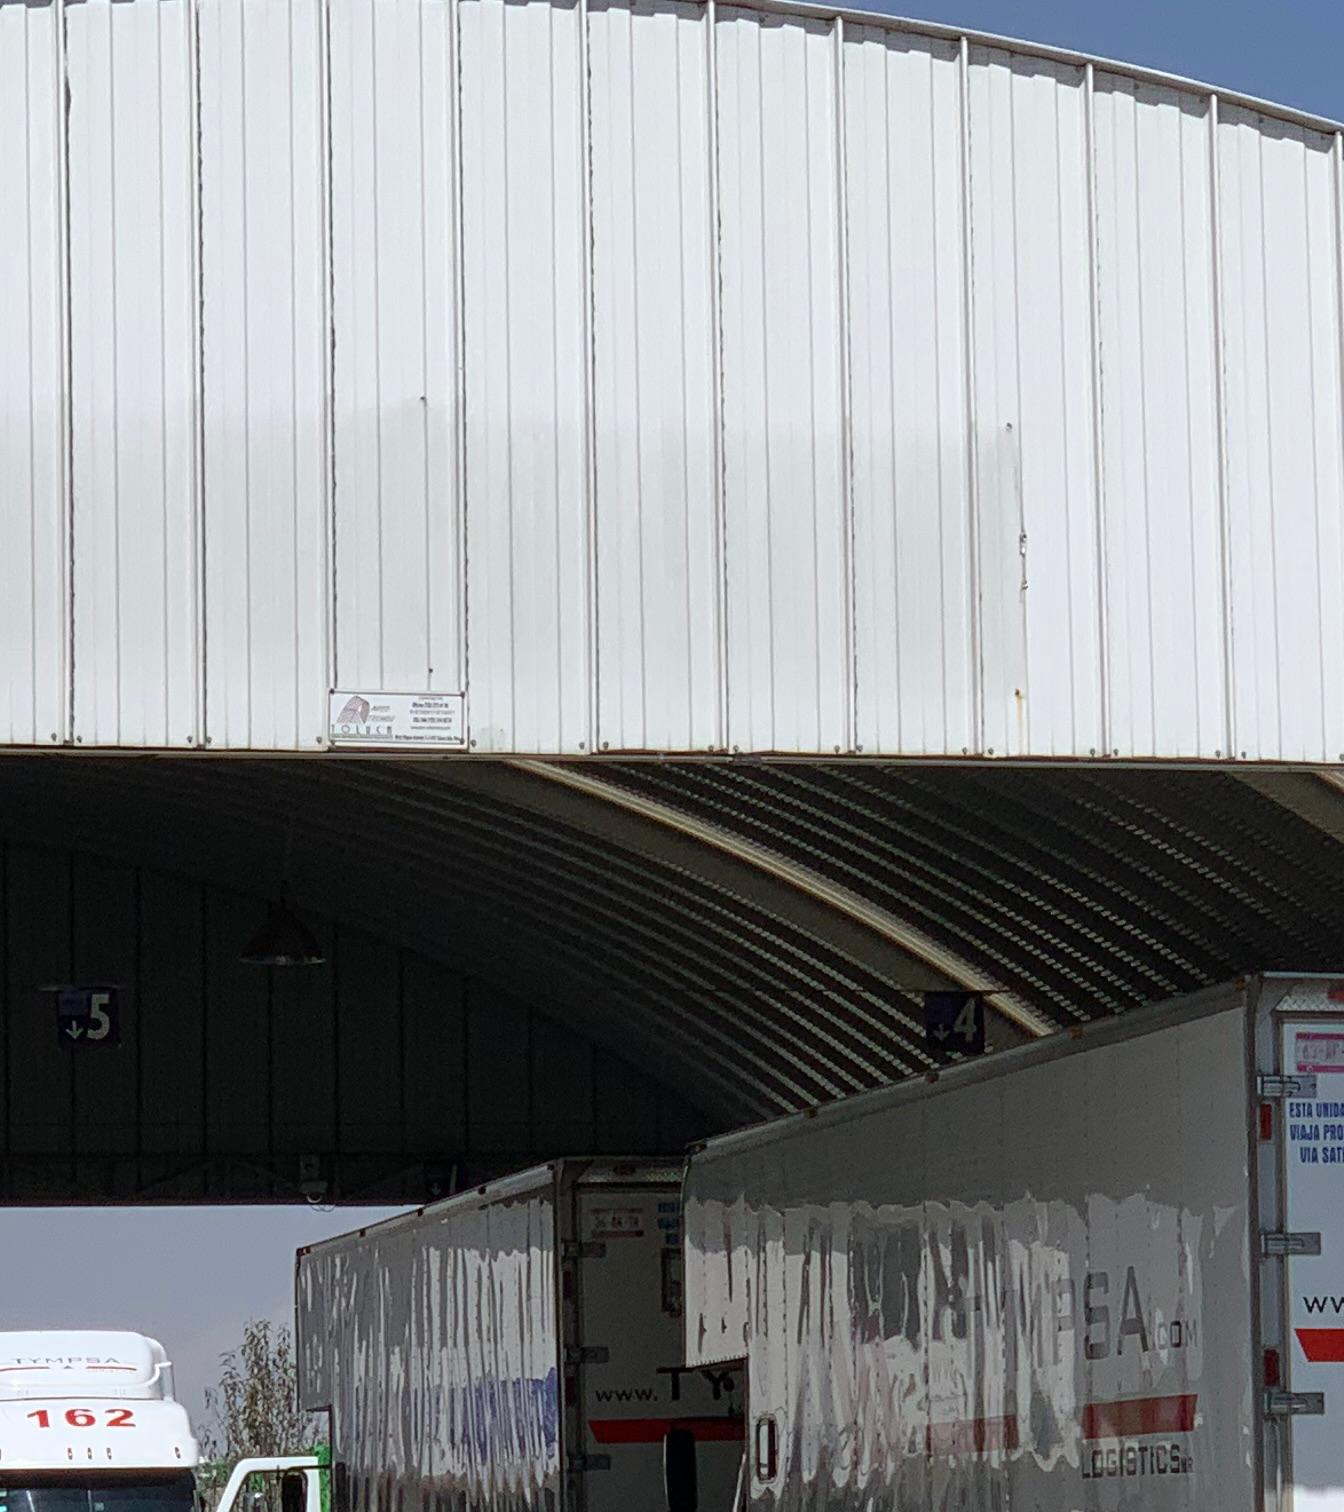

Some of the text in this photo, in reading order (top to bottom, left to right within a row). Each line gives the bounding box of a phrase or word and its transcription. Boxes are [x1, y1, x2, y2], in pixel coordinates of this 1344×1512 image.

[87, 994, 110, 1039] 5
[954, 999, 977, 1041] 4
[1289, 1102, 1313, 1118] ESTA
[1289, 1124, 1320, 1141] VIAJA
[1299, 1147, 1319, 1163] VIA
[10, 1356, 122, 1365] TYMPSA
[27, 1407, 137, 1429] 162
[1081, 1443, 1180, 1479] LOGISTICS
